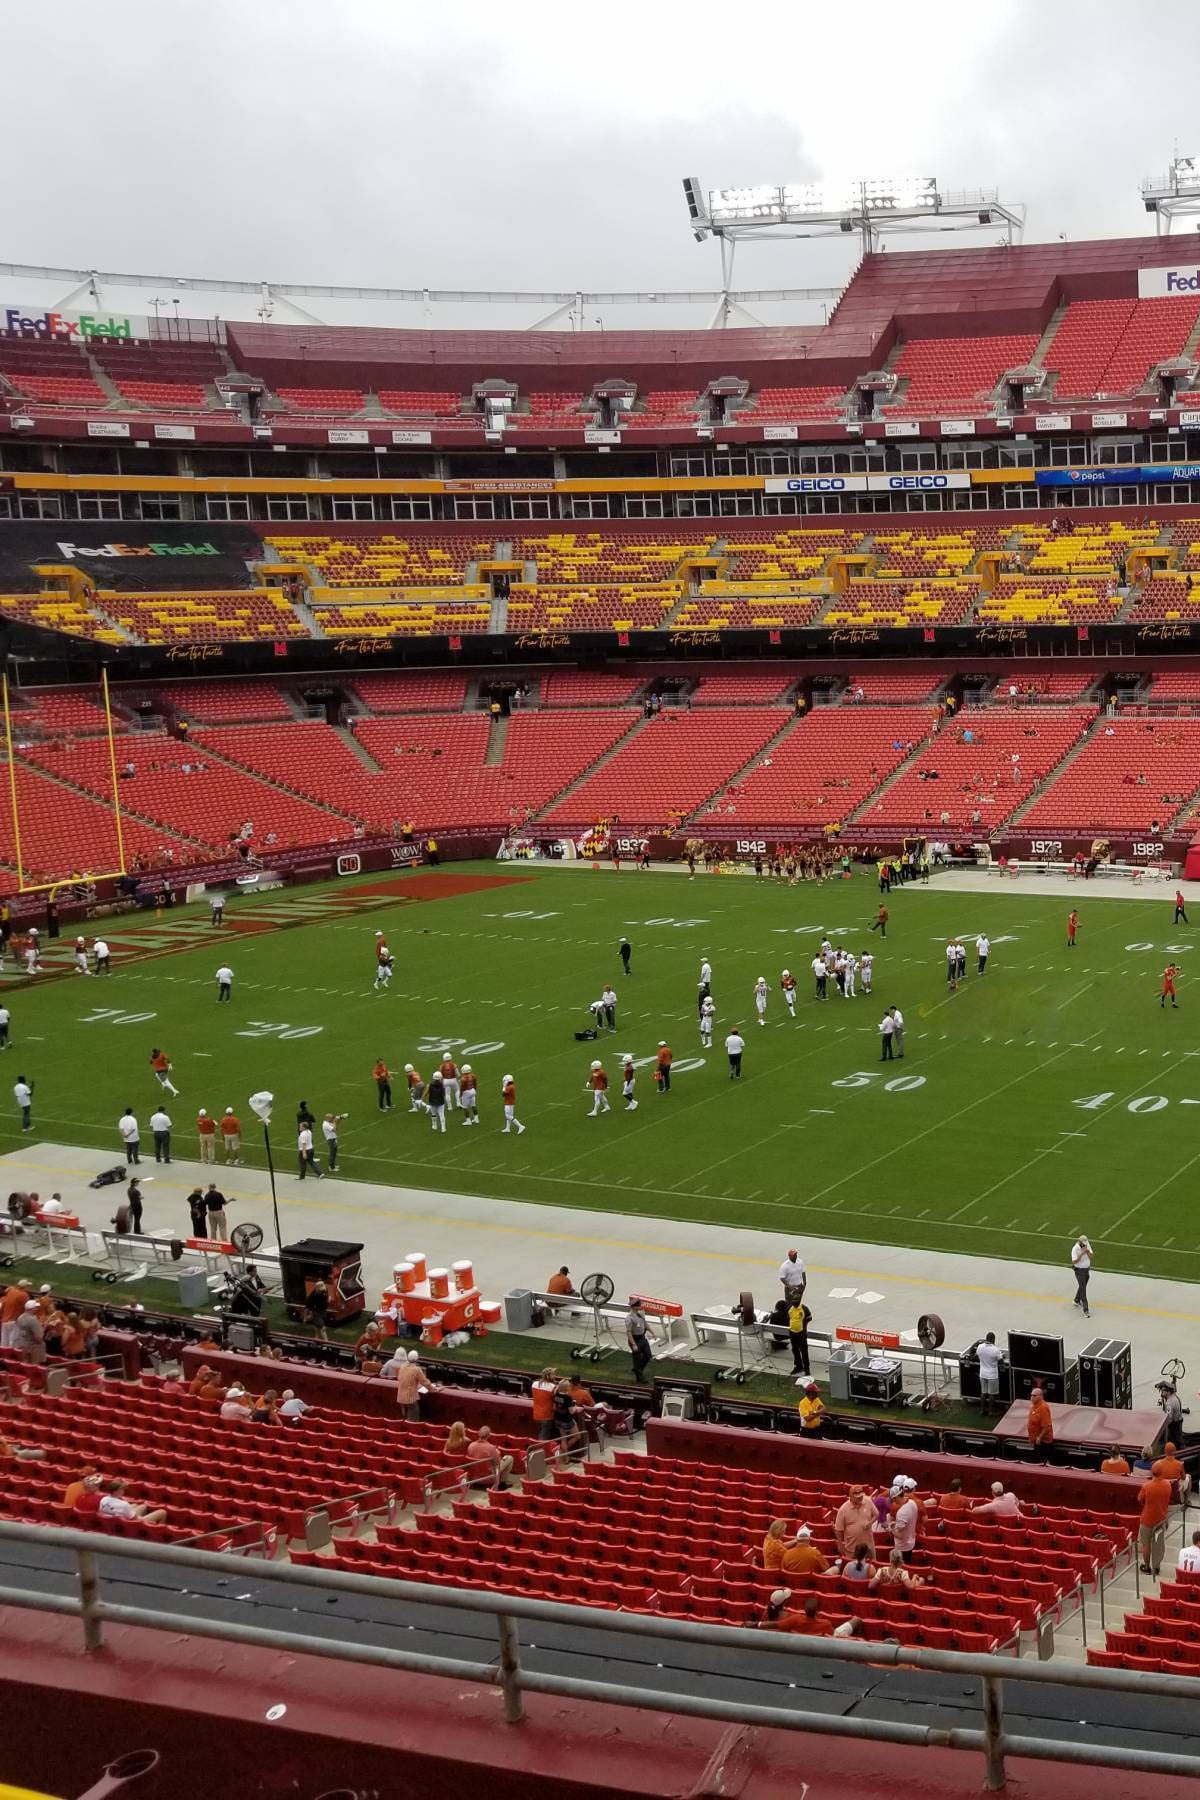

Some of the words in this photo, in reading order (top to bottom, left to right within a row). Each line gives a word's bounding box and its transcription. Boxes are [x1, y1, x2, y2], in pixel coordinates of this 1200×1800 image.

[6, 309, 131, 339] FedExField
[889, 475, 948, 489] GEICO
[1081, 472, 1106, 481] pepsi
[787, 478, 846, 491] GEICO
[57, 542, 222, 559] FedExField
[736, 840, 767, 853] 1942
[341, 857, 357, 871] 40
[79, 1008, 159, 1024] 10
[235, 1022, 325, 1039] 20
[417, 1037, 506, 1055] 30
[832, 1071, 927, 1092] 50
[1071, 1092, 1169, 1113] 40
[464, 1303, 474, 1318] G
[640, 1302, 667, 1311] ATORADE
[849, 1332, 884, 1344] GATORADE
[1183, 1559, 1195, 1572] 11
